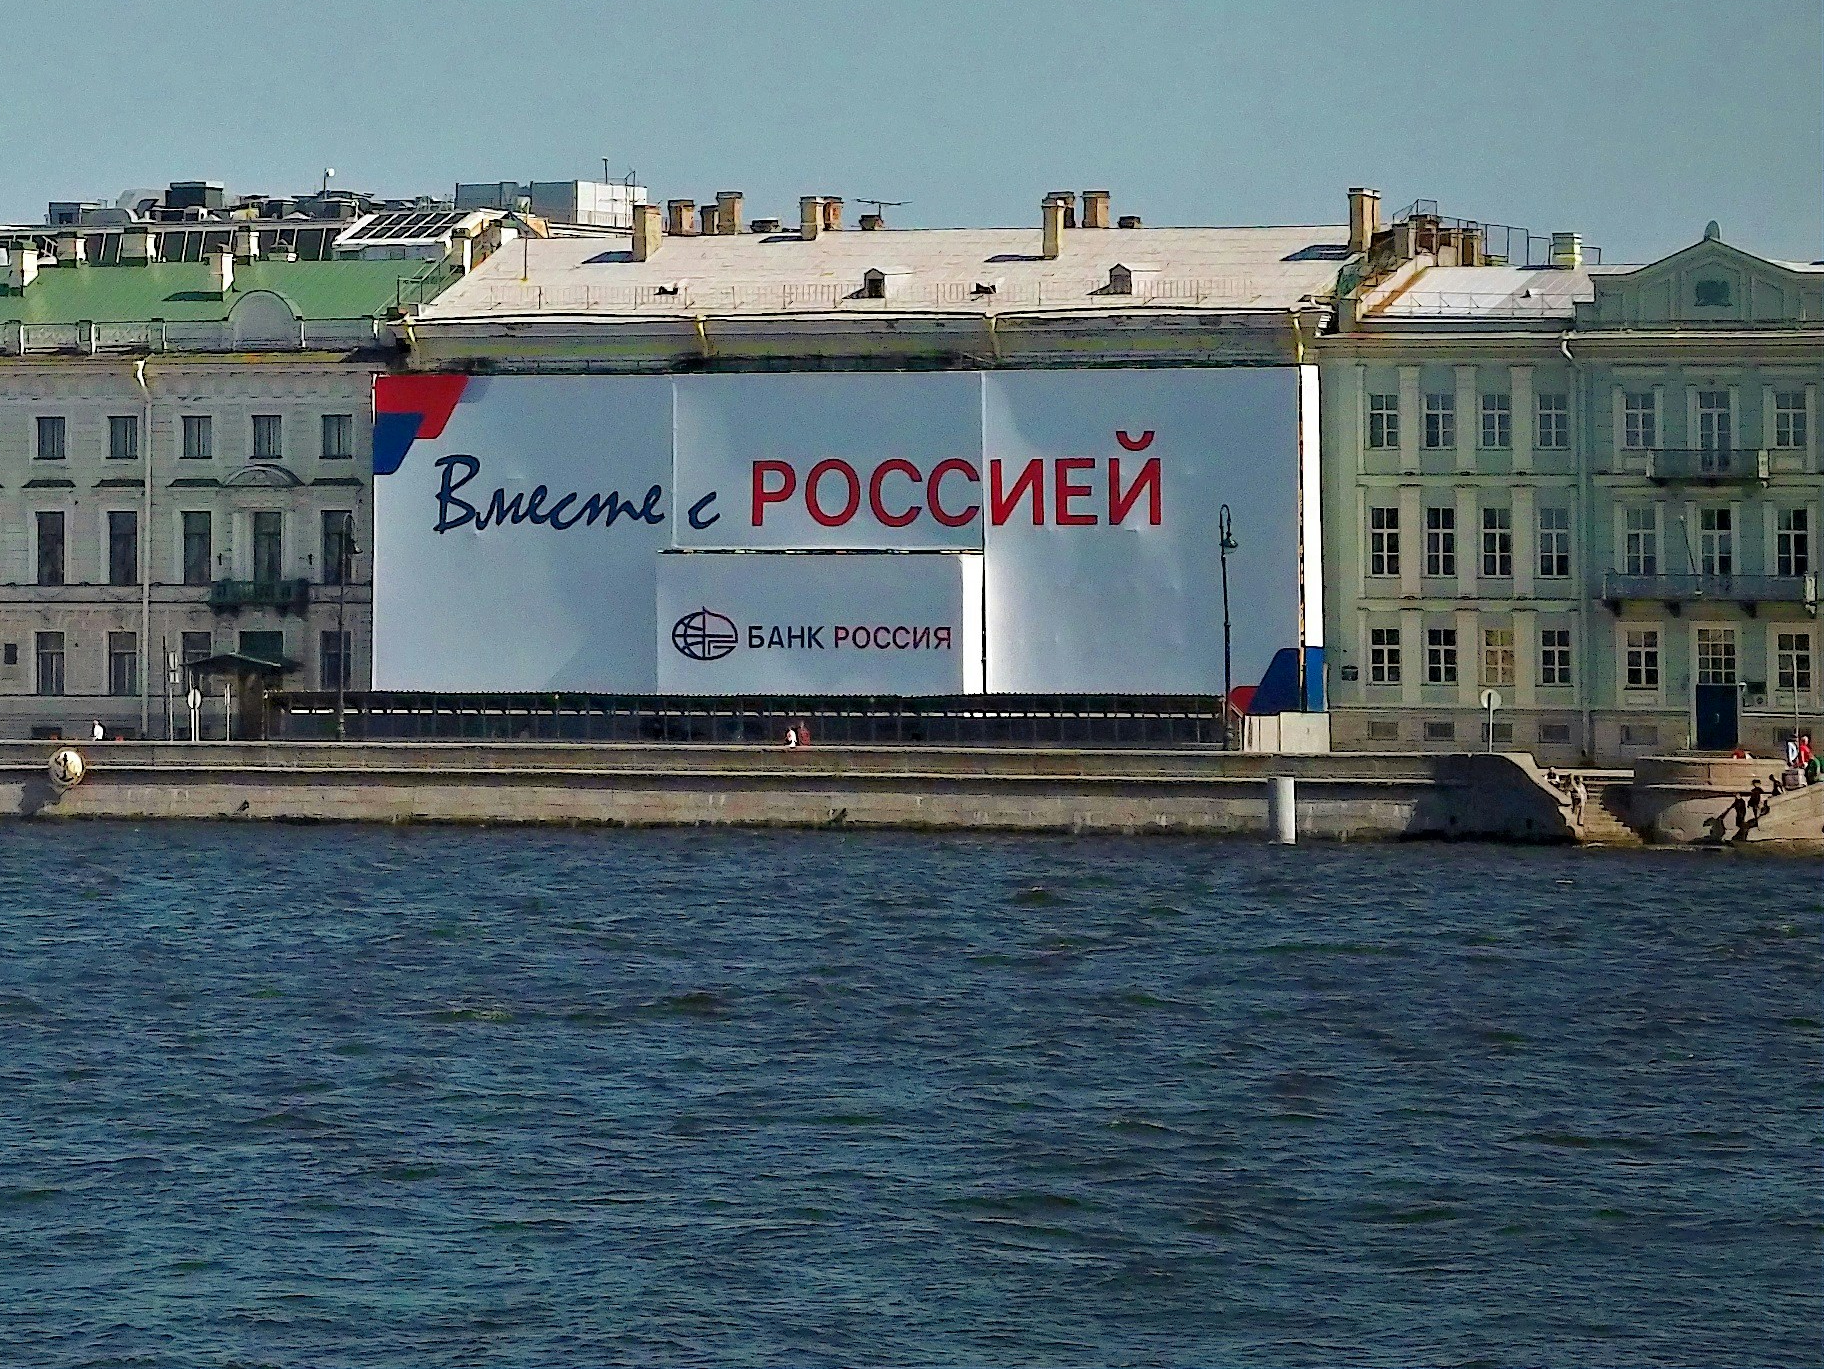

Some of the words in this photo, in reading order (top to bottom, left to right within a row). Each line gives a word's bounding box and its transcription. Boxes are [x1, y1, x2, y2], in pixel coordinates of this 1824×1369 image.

[434, 453, 665, 535] Вместе
[688, 490, 721, 531] с
[752, 430, 1162, 526] РОССИЕЙ
[747, 625, 825, 650] БАНК
[834, 625, 952, 650] РОССИЯ
